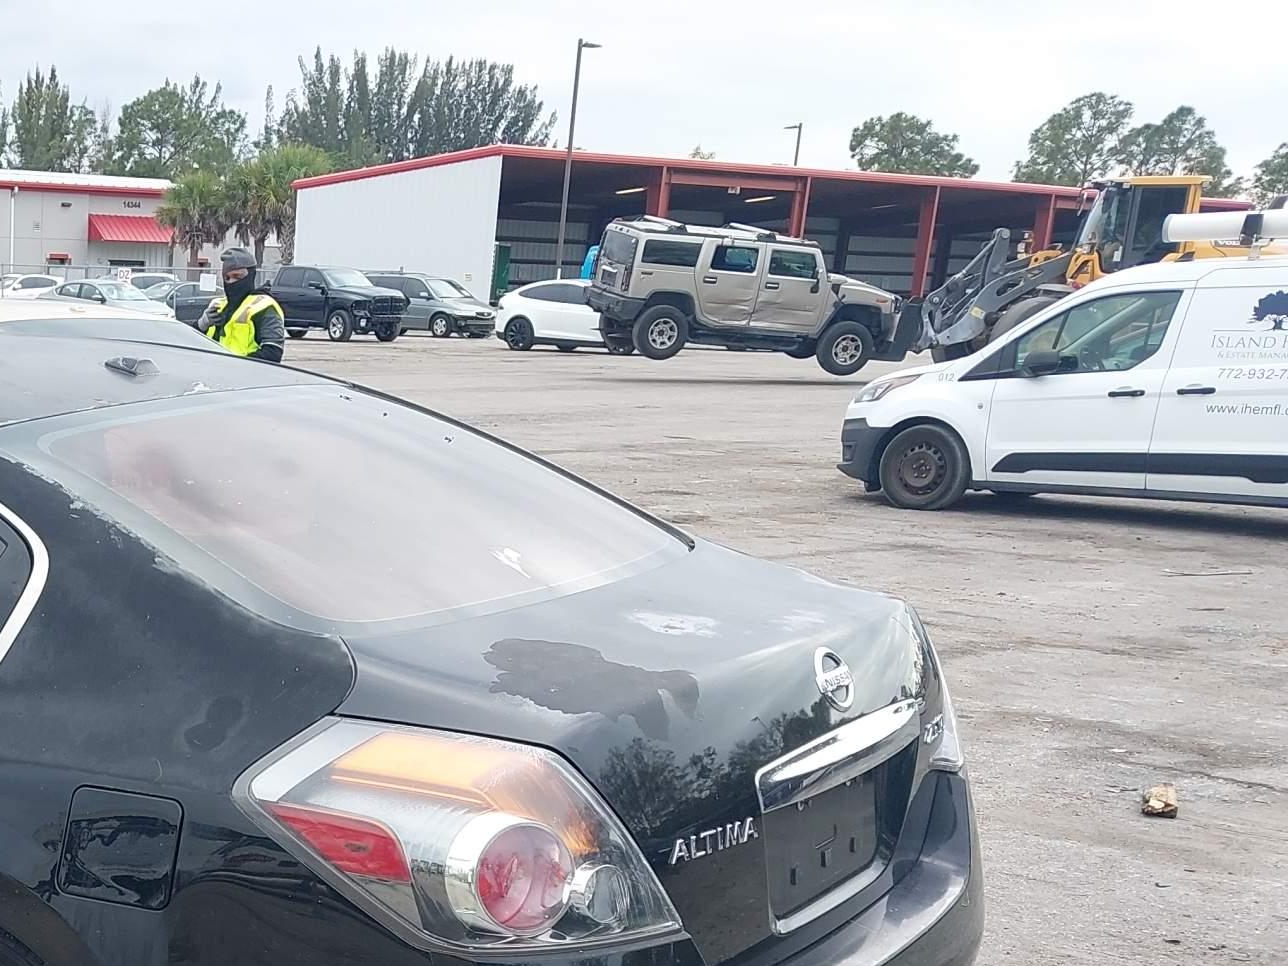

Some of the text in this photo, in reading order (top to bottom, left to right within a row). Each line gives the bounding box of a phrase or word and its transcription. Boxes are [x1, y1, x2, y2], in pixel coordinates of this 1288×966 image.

[1211, 334, 1277, 349] ISLAND
[1217, 367, 1288, 380] 772-932-7
[668, 817, 759, 865] ALTIMA
